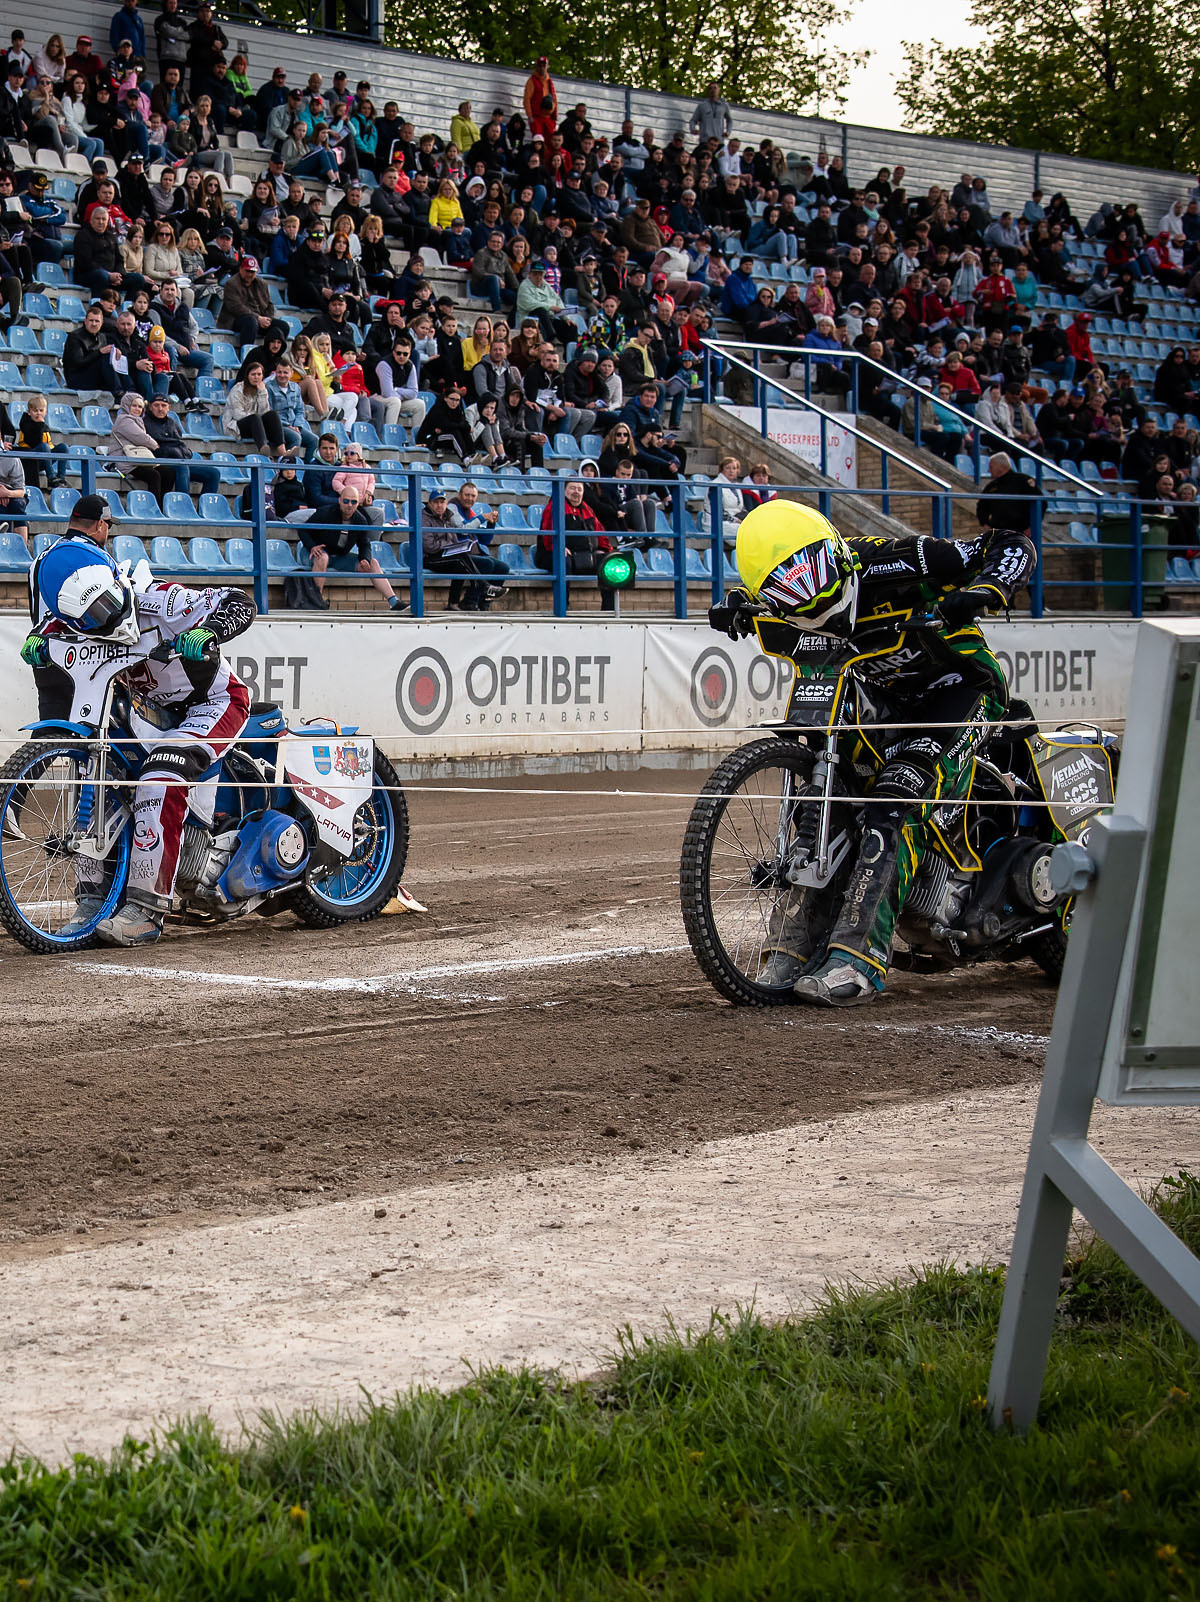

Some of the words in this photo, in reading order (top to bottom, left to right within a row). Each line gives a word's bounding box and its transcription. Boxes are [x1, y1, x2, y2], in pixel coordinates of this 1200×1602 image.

[785, 564, 807, 583] SHOEI
[81, 584, 99, 602] SHOEI
[465, 655, 611, 707] OPTIBET
[795, 685, 835, 697] ACDC
[466, 712, 546, 725] SPORTA
[562, 709, 609, 723] BĀRS
[1060, 768, 1090, 788] RECYCLING
[316, 814, 352, 841] LATVIA
